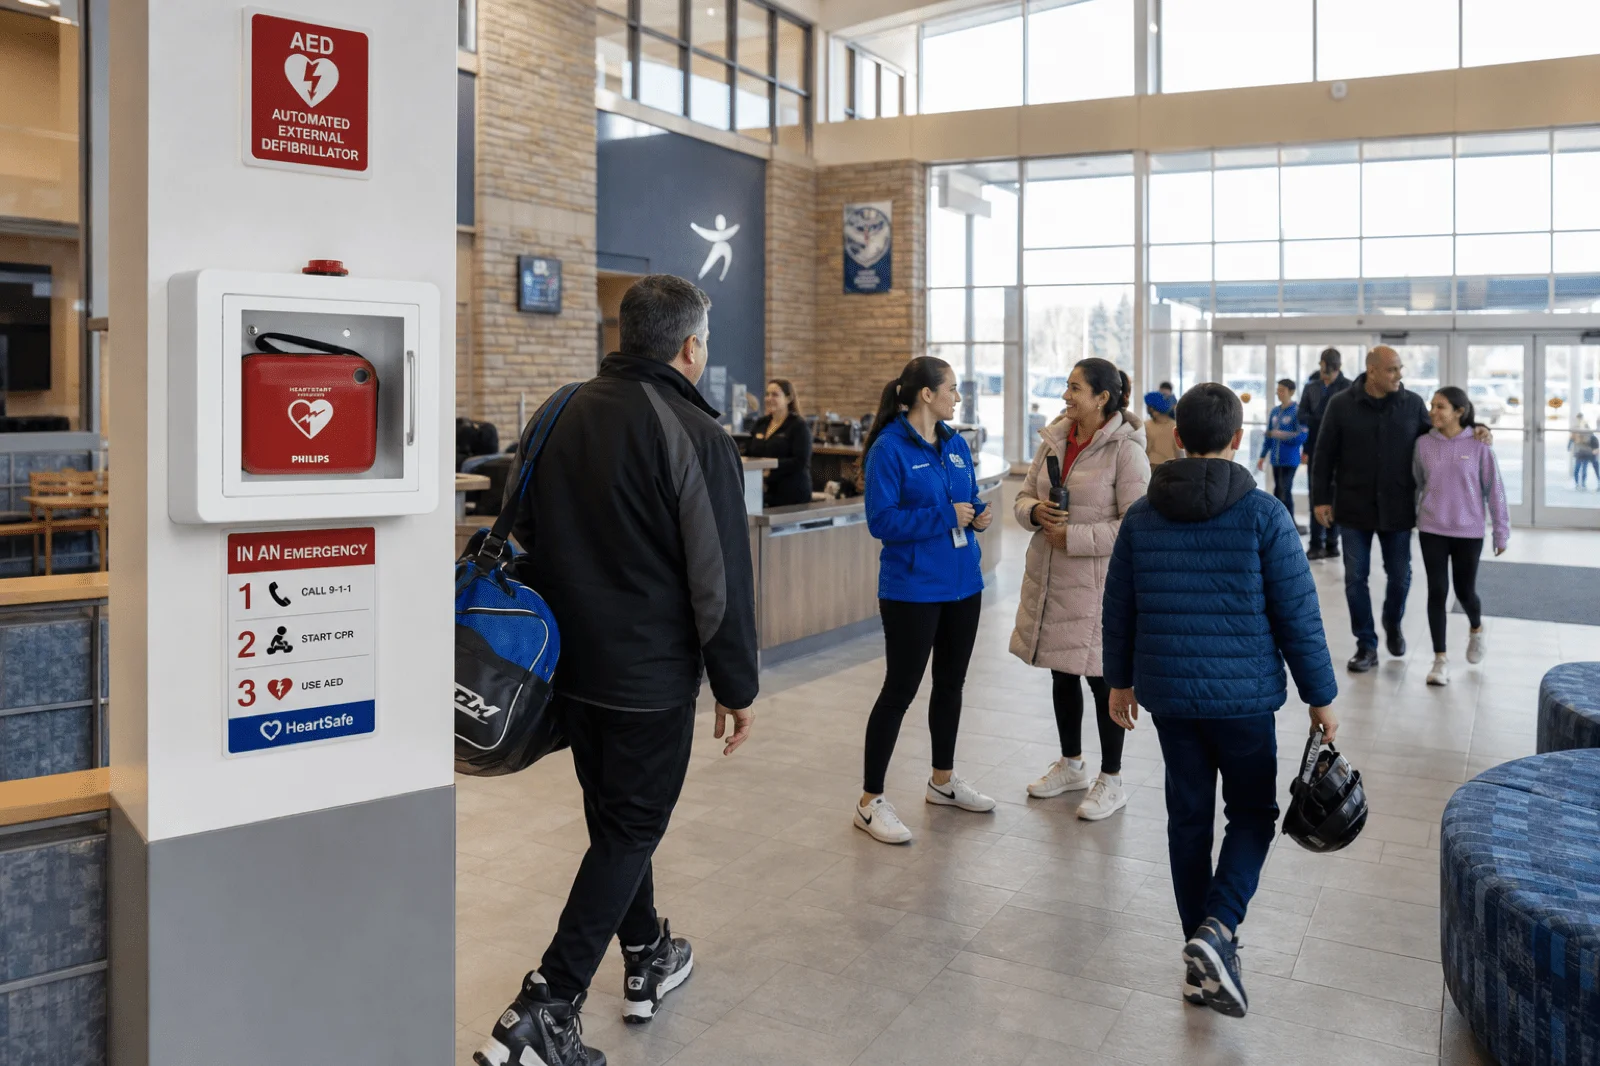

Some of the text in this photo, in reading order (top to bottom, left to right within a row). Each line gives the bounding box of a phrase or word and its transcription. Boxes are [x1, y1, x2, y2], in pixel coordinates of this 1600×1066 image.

[289, 31, 334, 55] AED
[272, 108, 350, 130] AUTOMATED
[278, 125, 345, 144] EXTERNAL
[262, 138, 359, 161] DEFIBRILLATOR
[291, 455, 329, 463] PHILIPS
[236, 543, 368, 562] IN AN EMERGENCY
[238, 582, 352, 610] 1 CALL 9-1-1
[237, 629, 354, 659] 2 START CPR
[237, 677, 344, 708] 3 USE AED
[285, 713, 354, 735] HeartSafe
